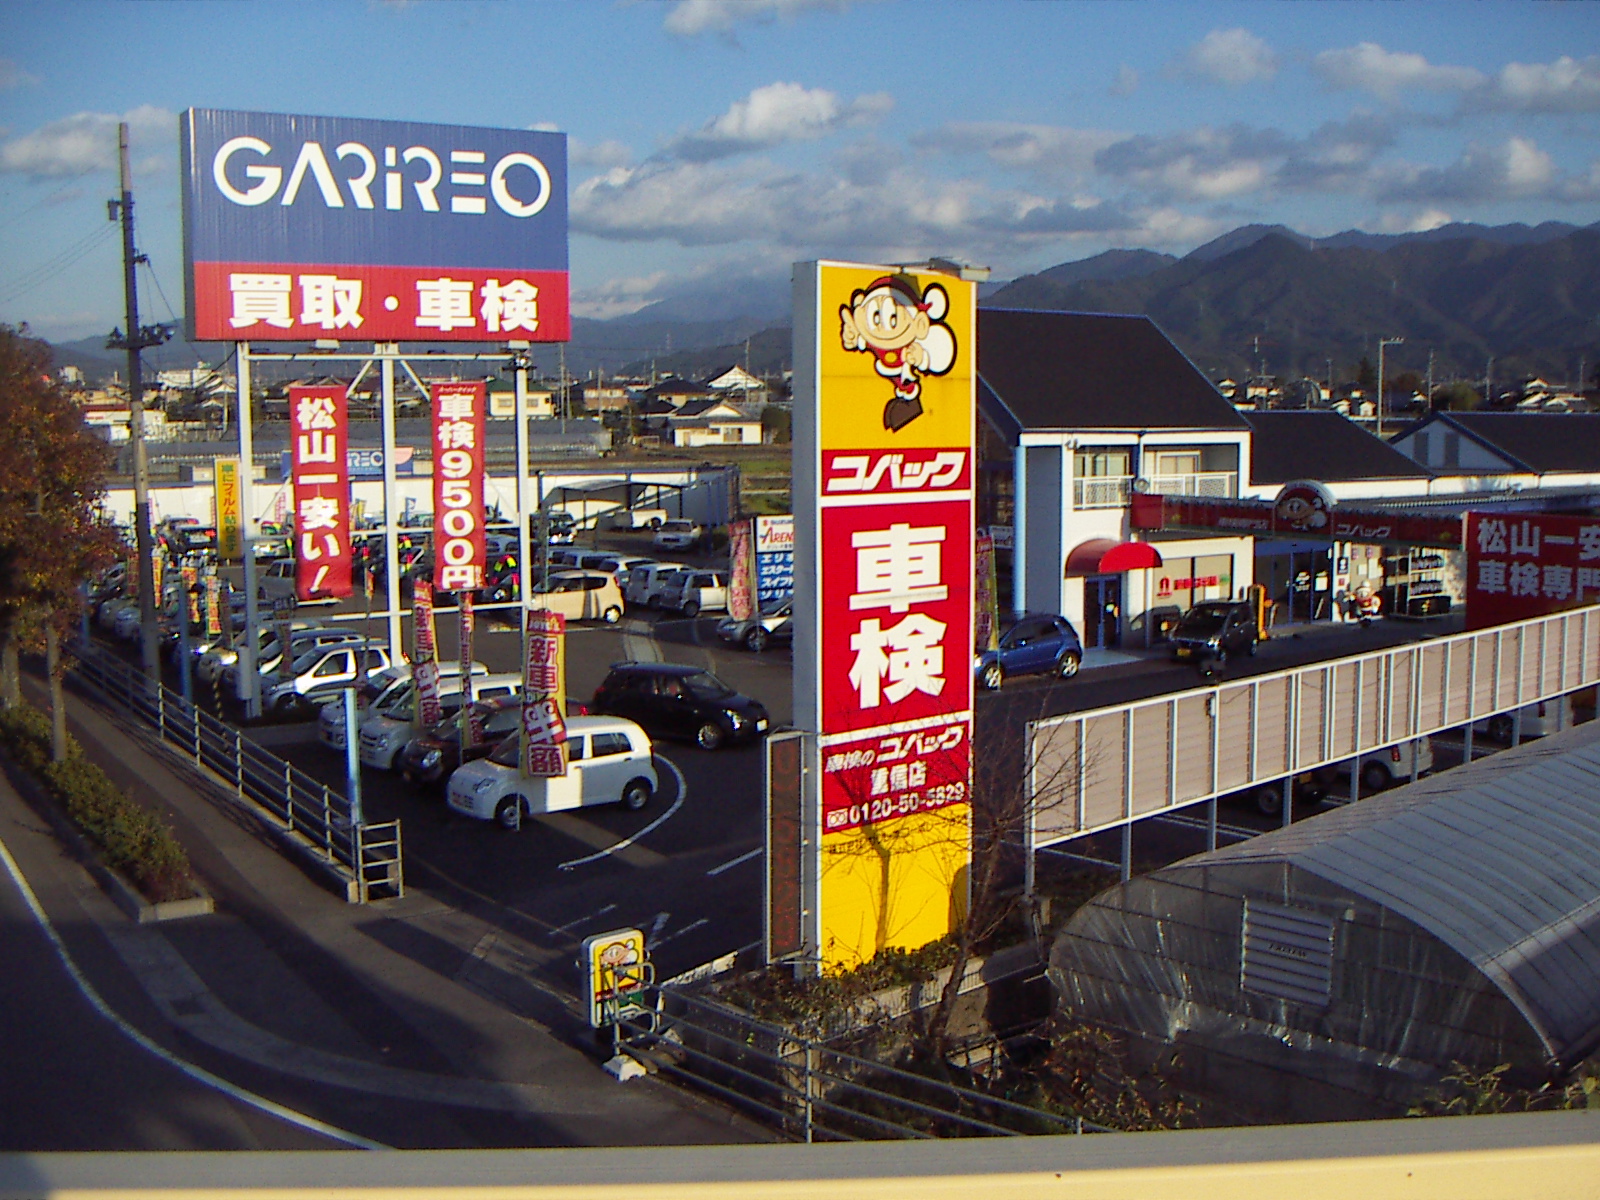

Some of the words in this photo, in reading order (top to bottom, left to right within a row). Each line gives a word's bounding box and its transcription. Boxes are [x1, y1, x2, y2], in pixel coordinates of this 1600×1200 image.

[229, 273, 540, 332] 買取・車検
[827, 452, 966, 491] コバック
[849, 523, 948, 709] 車検
[877, 725, 965, 762] コバック
